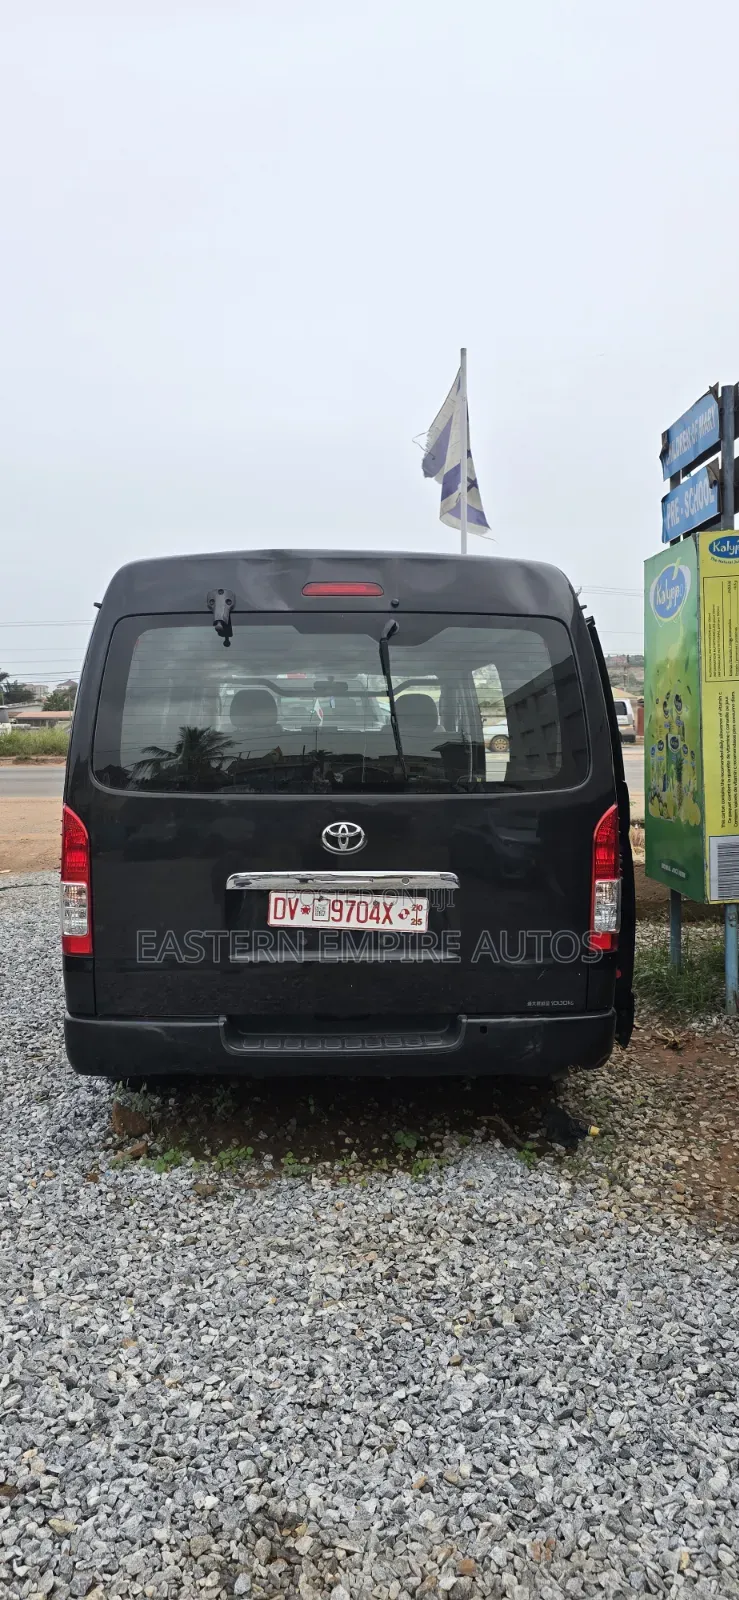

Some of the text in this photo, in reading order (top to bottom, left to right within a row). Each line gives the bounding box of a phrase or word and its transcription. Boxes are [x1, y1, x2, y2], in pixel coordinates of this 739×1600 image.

[699, 403, 717, 439] MARY
[666, 497, 680, 529] PRE
[273, 897, 394, 925] DV 9704X
[410, 918, 423, 926] 25
